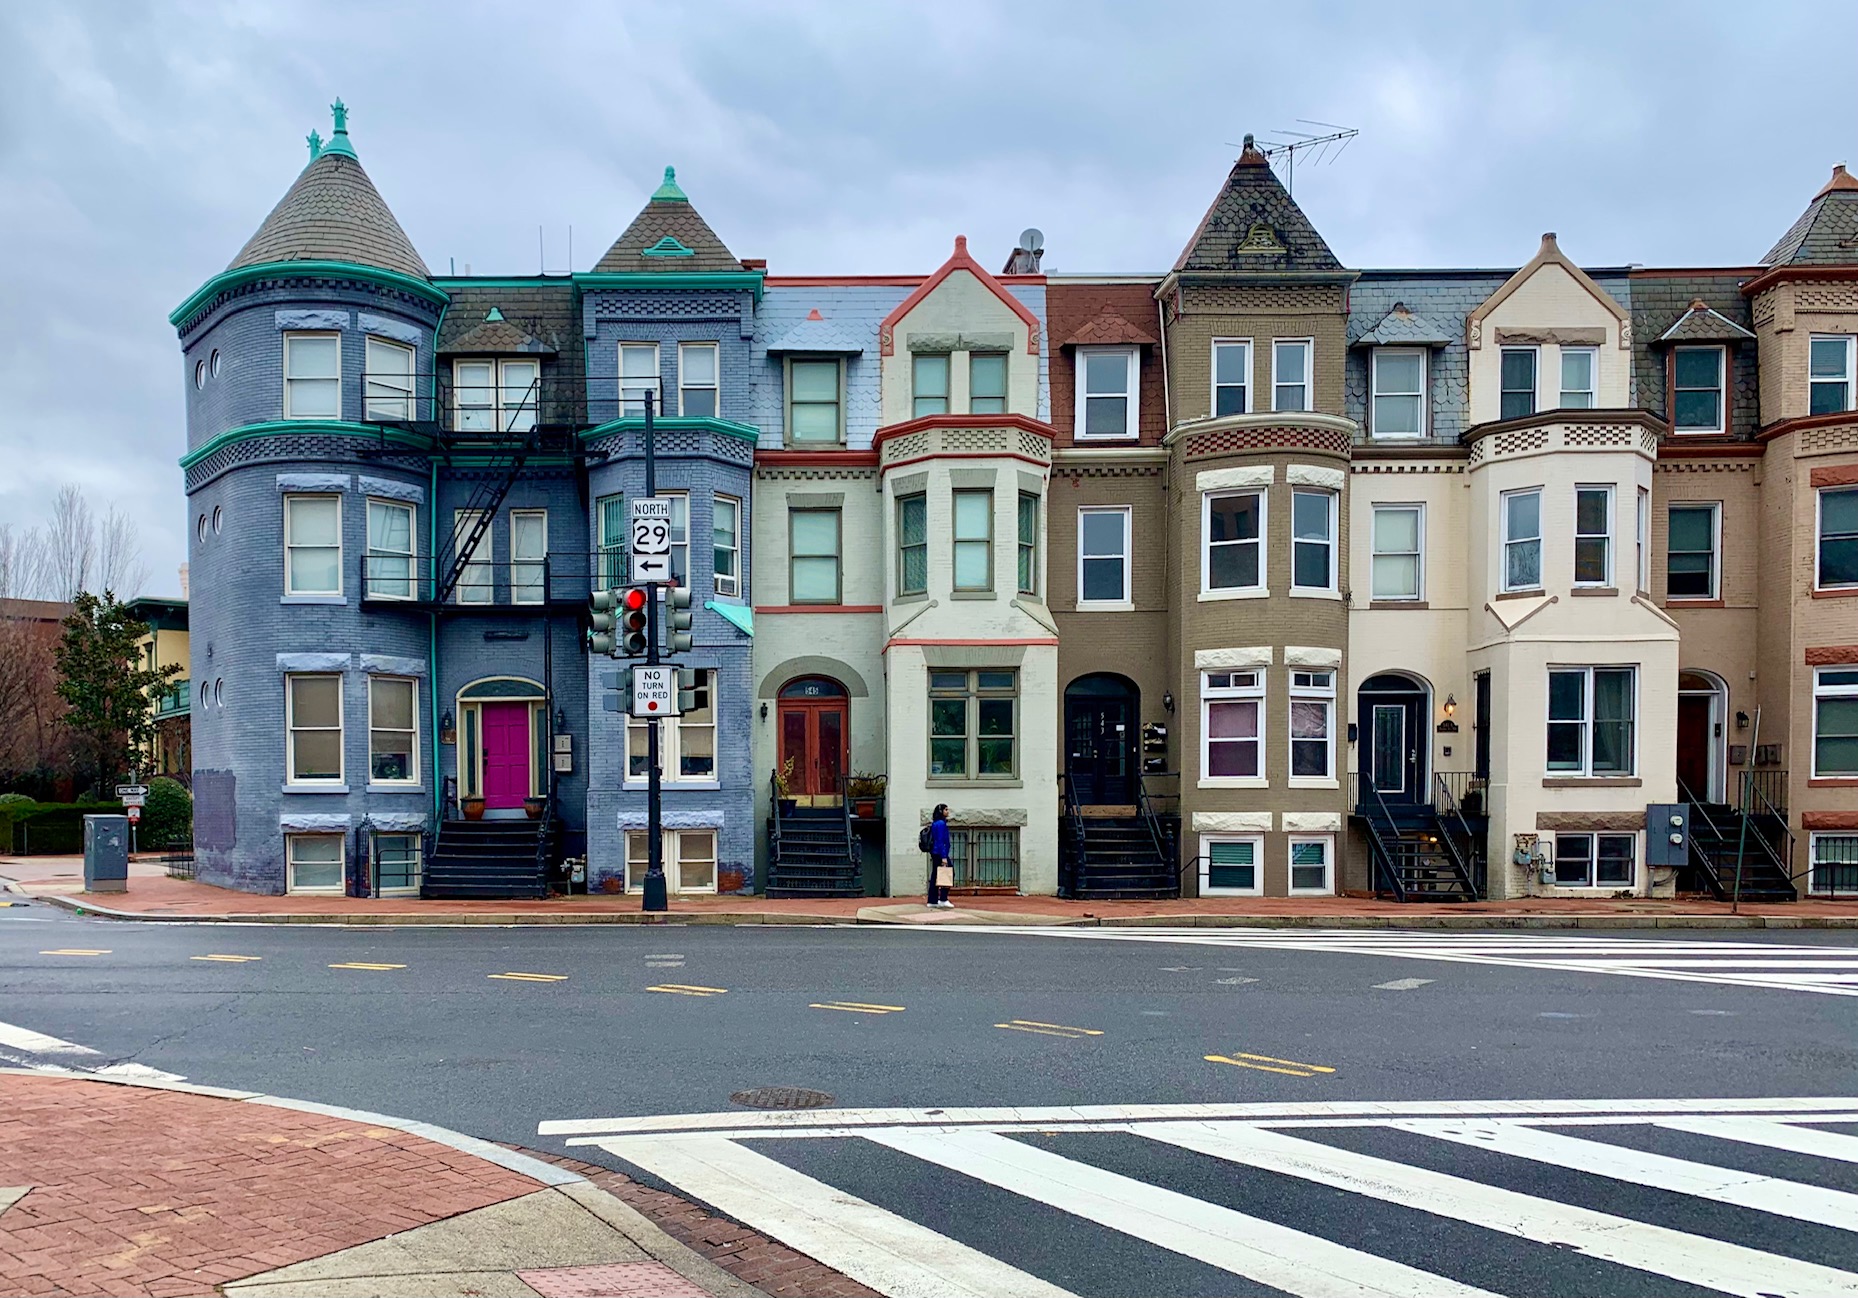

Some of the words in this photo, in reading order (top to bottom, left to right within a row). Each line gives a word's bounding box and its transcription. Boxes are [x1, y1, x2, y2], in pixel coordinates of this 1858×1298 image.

[634, 503, 668, 515] NORTH
[636, 525, 666, 545] 29
[644, 671, 661, 680] NO
[642, 682, 664, 690] TURN
[637, 691, 649, 700] ON
[652, 691, 669, 699] RED
